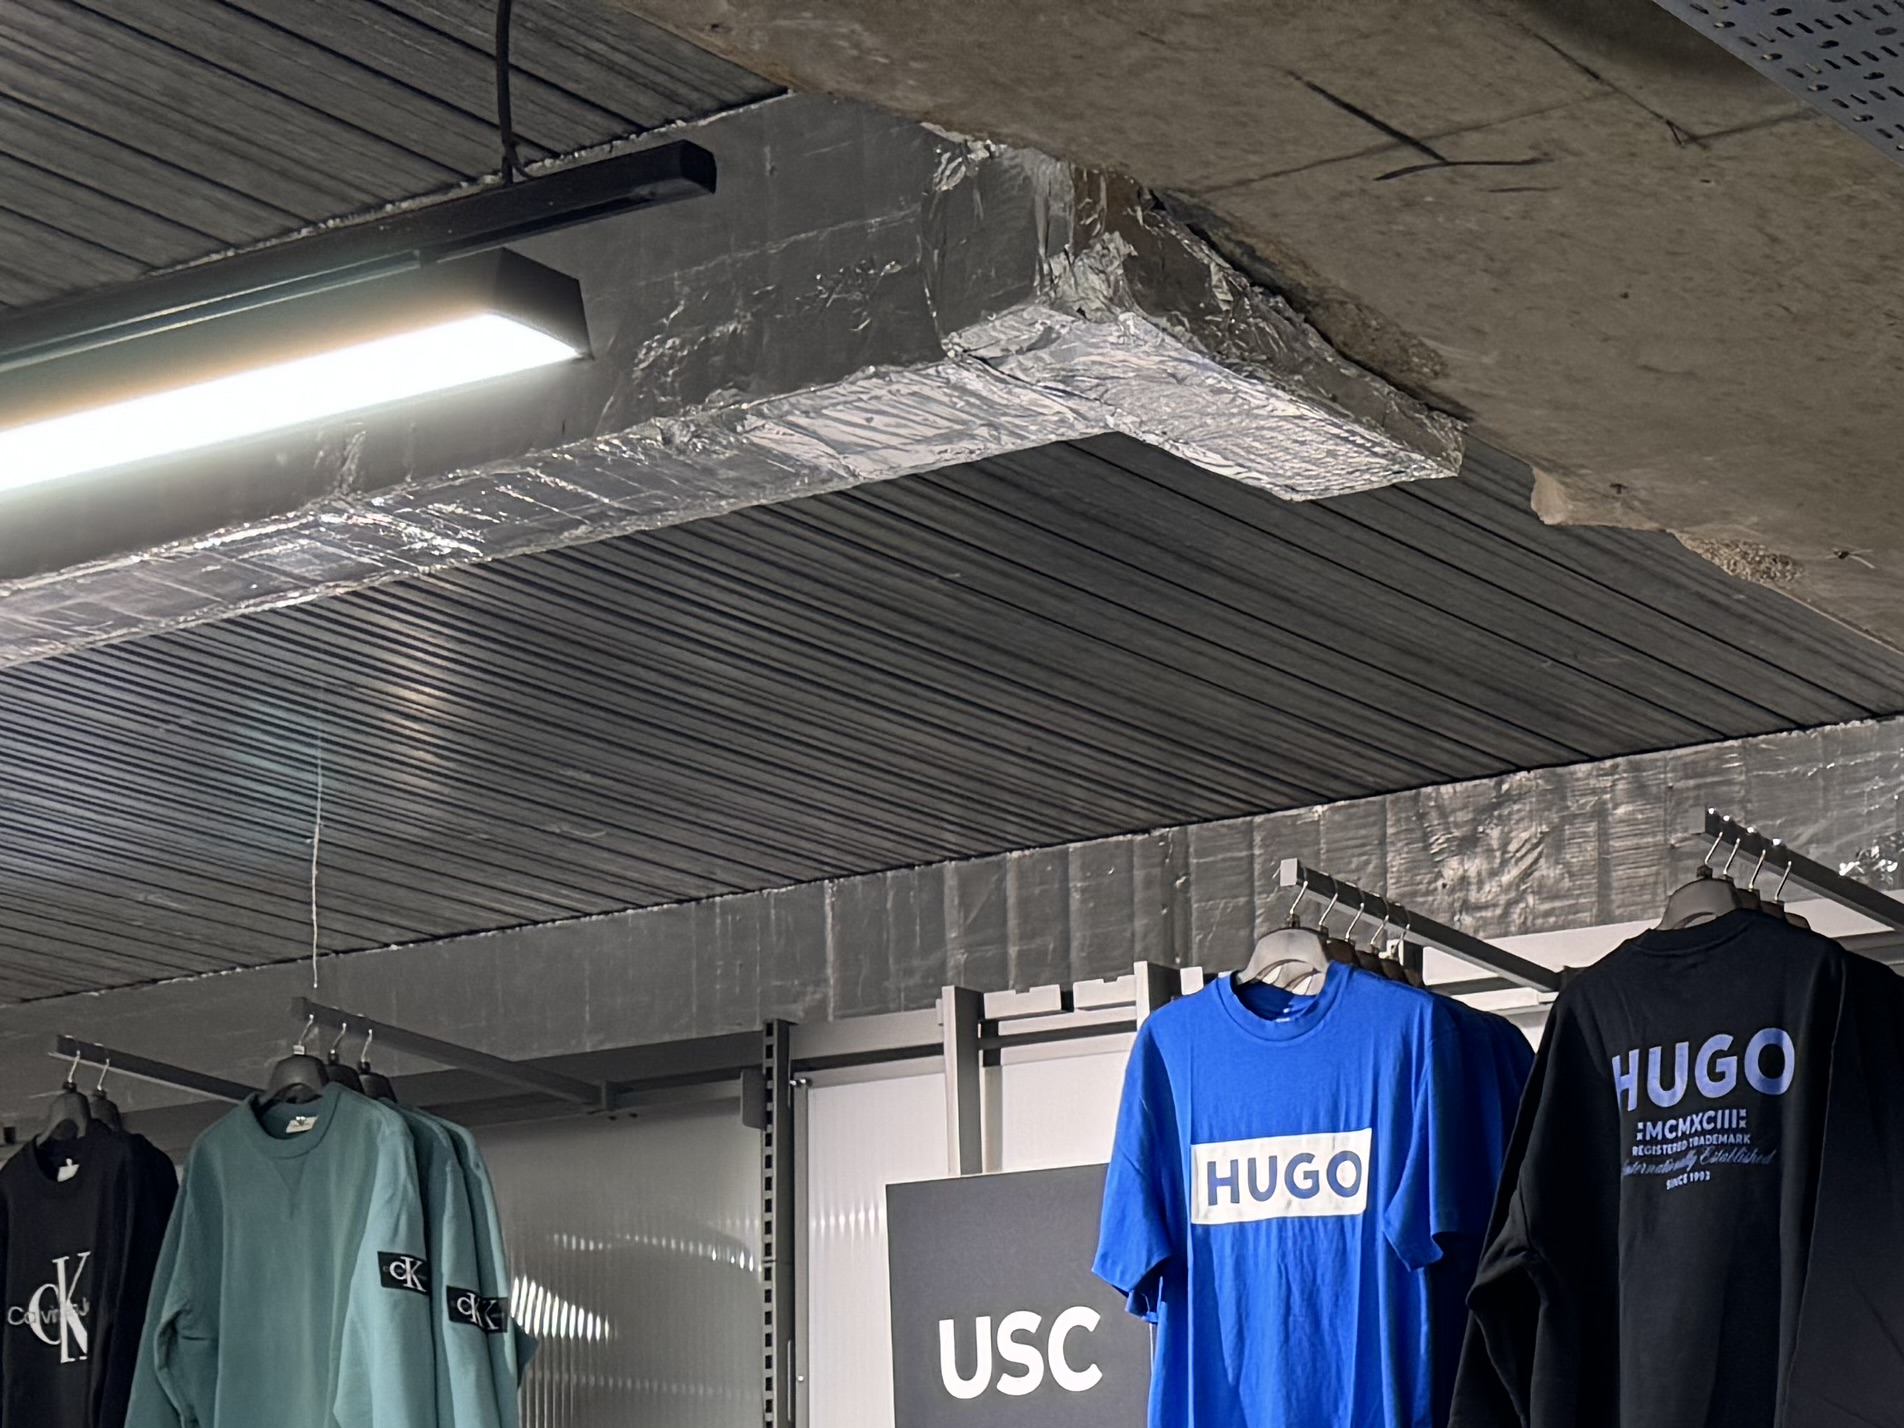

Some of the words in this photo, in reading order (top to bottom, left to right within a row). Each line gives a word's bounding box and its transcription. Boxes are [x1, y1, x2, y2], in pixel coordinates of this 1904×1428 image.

[1612, 1027, 1795, 1112] HUGO
[1632, 1139, 1687, 1157] REGISTERED
[1689, 1133, 1751, 1148] TRADEMARK
[1645, 1109, 1738, 1141] MCMXCIII
[1207, 1150, 1361, 1206] HUGO
[1666, 1173, 1688, 1190] SINCE
[939, 1306, 1102, 1399] USC
